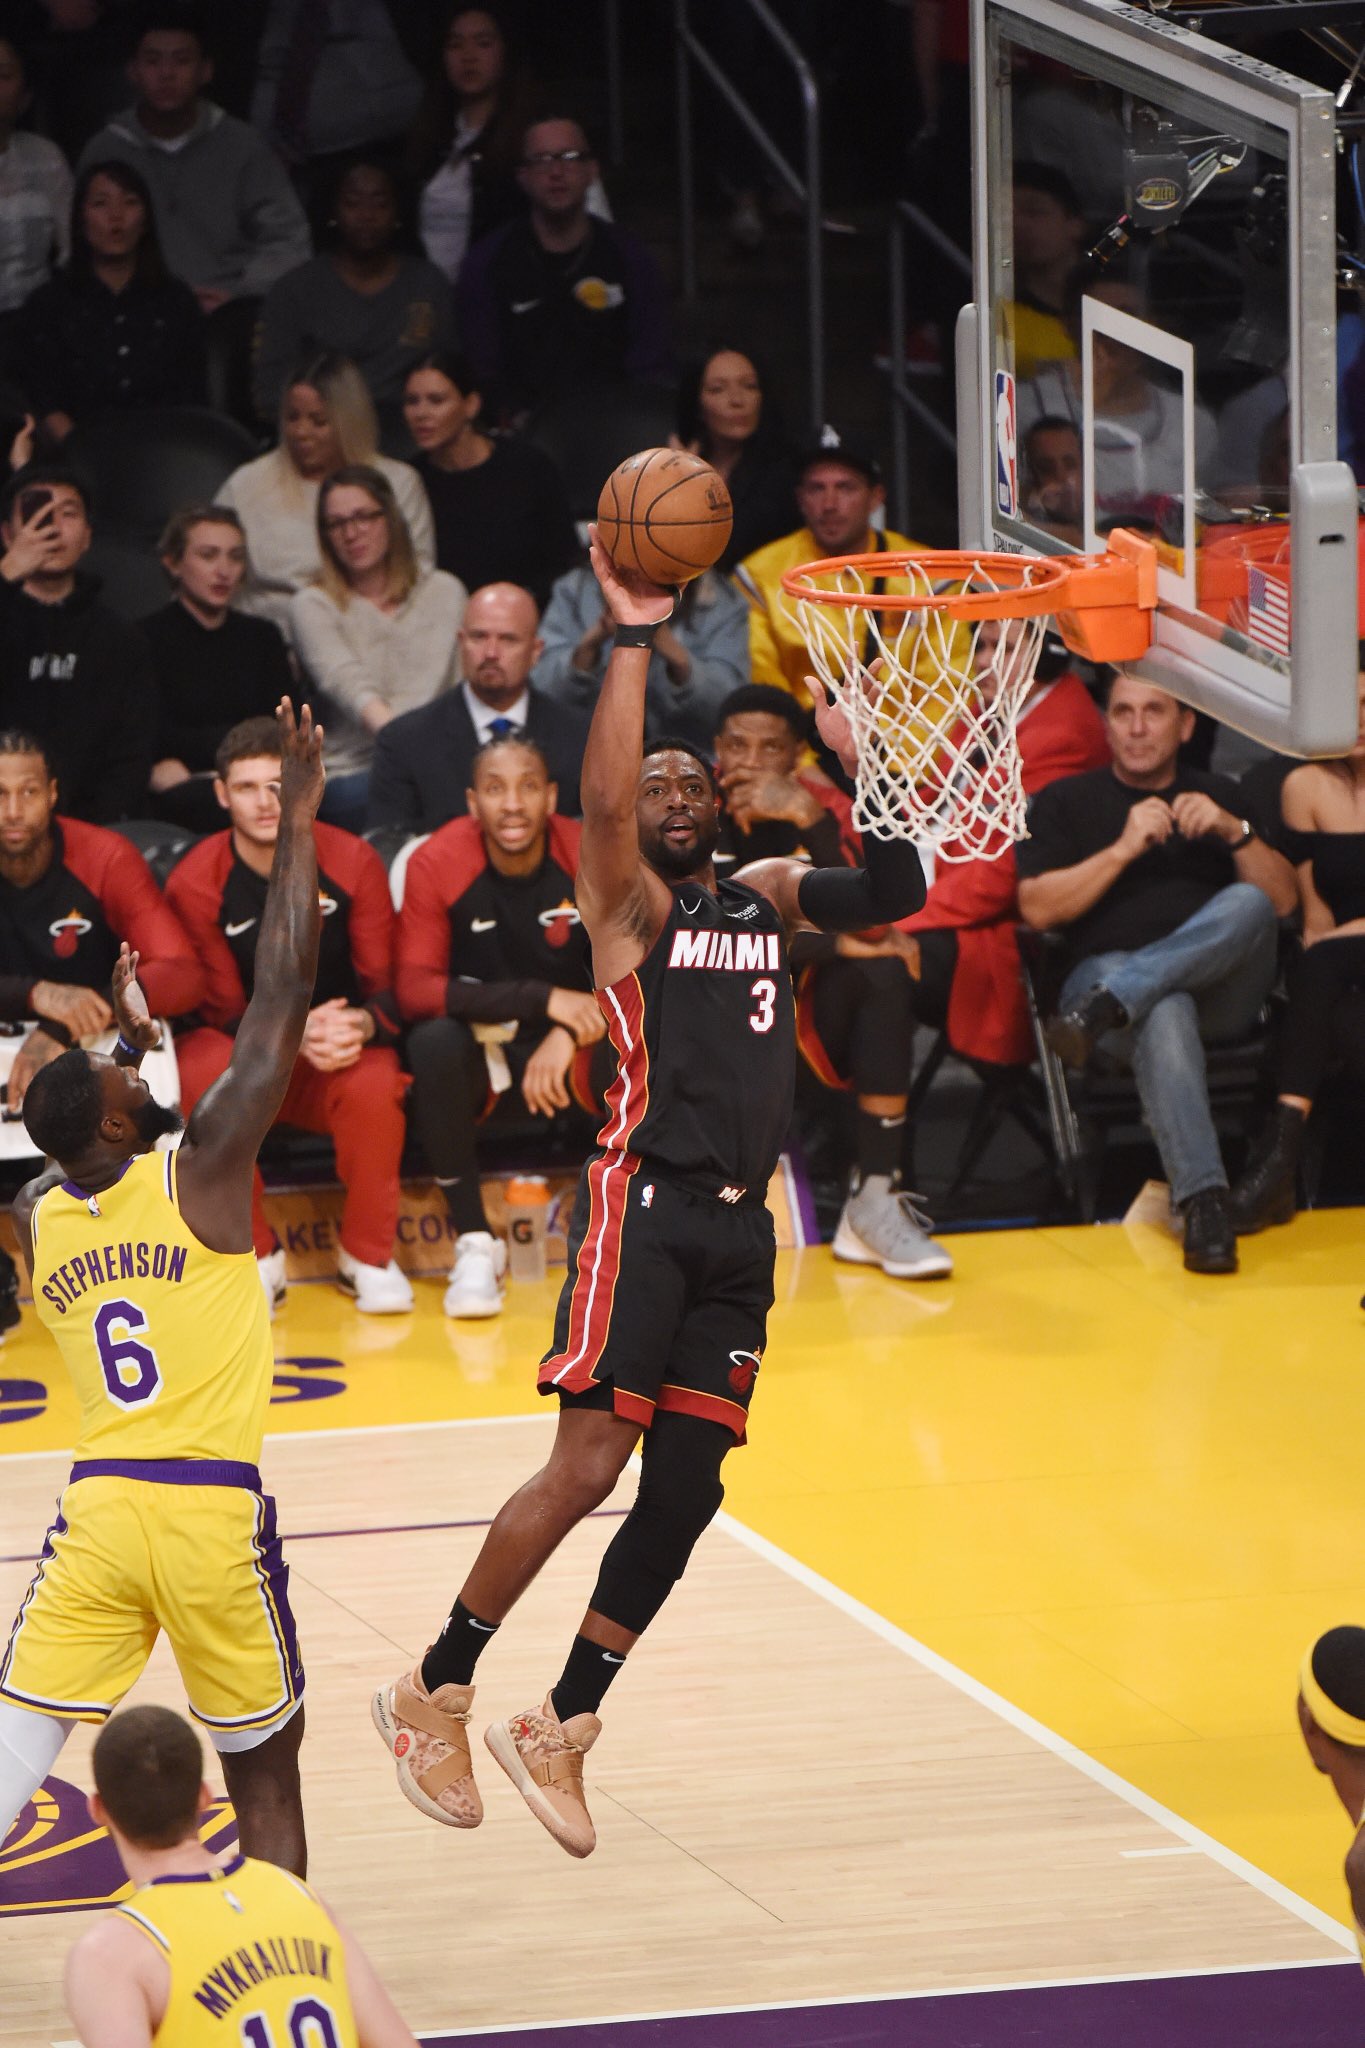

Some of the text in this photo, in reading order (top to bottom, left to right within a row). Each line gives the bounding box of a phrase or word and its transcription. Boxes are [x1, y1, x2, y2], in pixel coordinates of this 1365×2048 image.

[668, 929, 780, 971] MIAMI
[750, 978, 776, 1033] 3
[512, 1218, 534, 1243] G
[41, 1242, 188, 1315] STEPHENSON
[94, 1297, 164, 1412] 6
[193, 1937, 332, 2020] MYKHAILIUK
